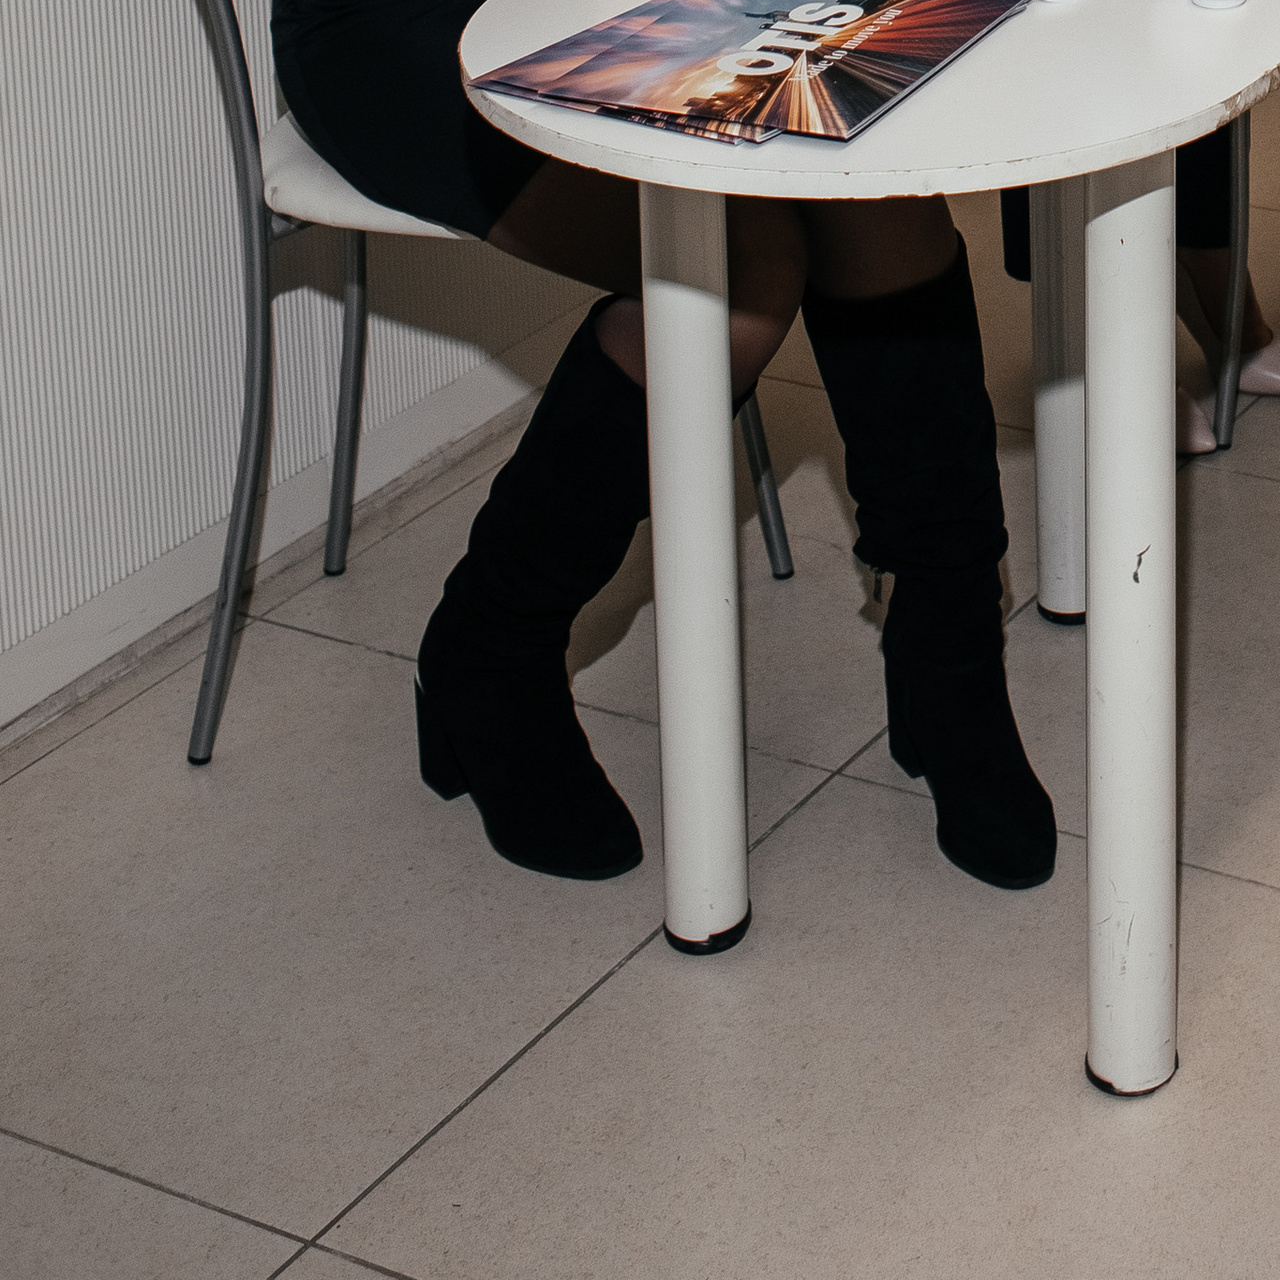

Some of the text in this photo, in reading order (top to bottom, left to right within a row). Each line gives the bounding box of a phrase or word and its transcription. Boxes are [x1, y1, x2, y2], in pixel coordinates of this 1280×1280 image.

[716, 2, 864, 76] OTIS
[824, 49, 848, 60] to
[841, 25, 880, 50] move
[872, 8, 903, 26] you
